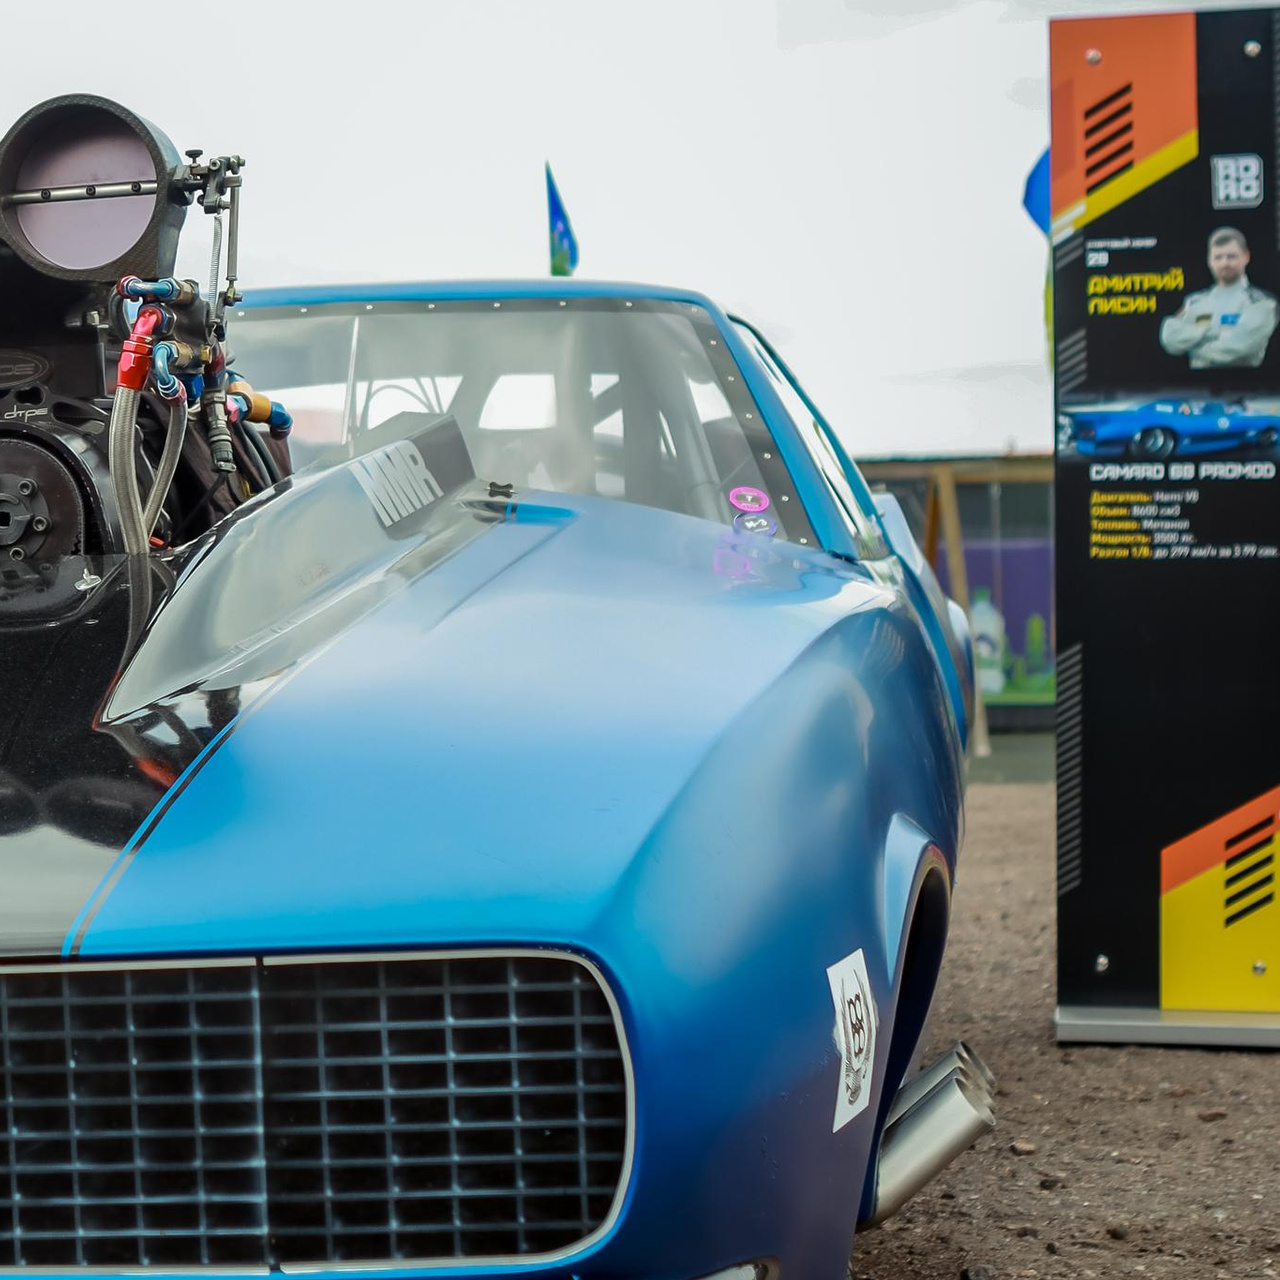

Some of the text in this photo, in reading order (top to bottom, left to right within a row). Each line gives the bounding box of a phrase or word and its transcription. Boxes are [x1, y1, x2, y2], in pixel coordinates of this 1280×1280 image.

[1087, 267, 1184, 295] ДМИТРИЙ
[347, 440, 445, 528] MMR
[1090, 463, 1165, 481] CAMARO
[1199, 461, 1276, 480] PROMOD
